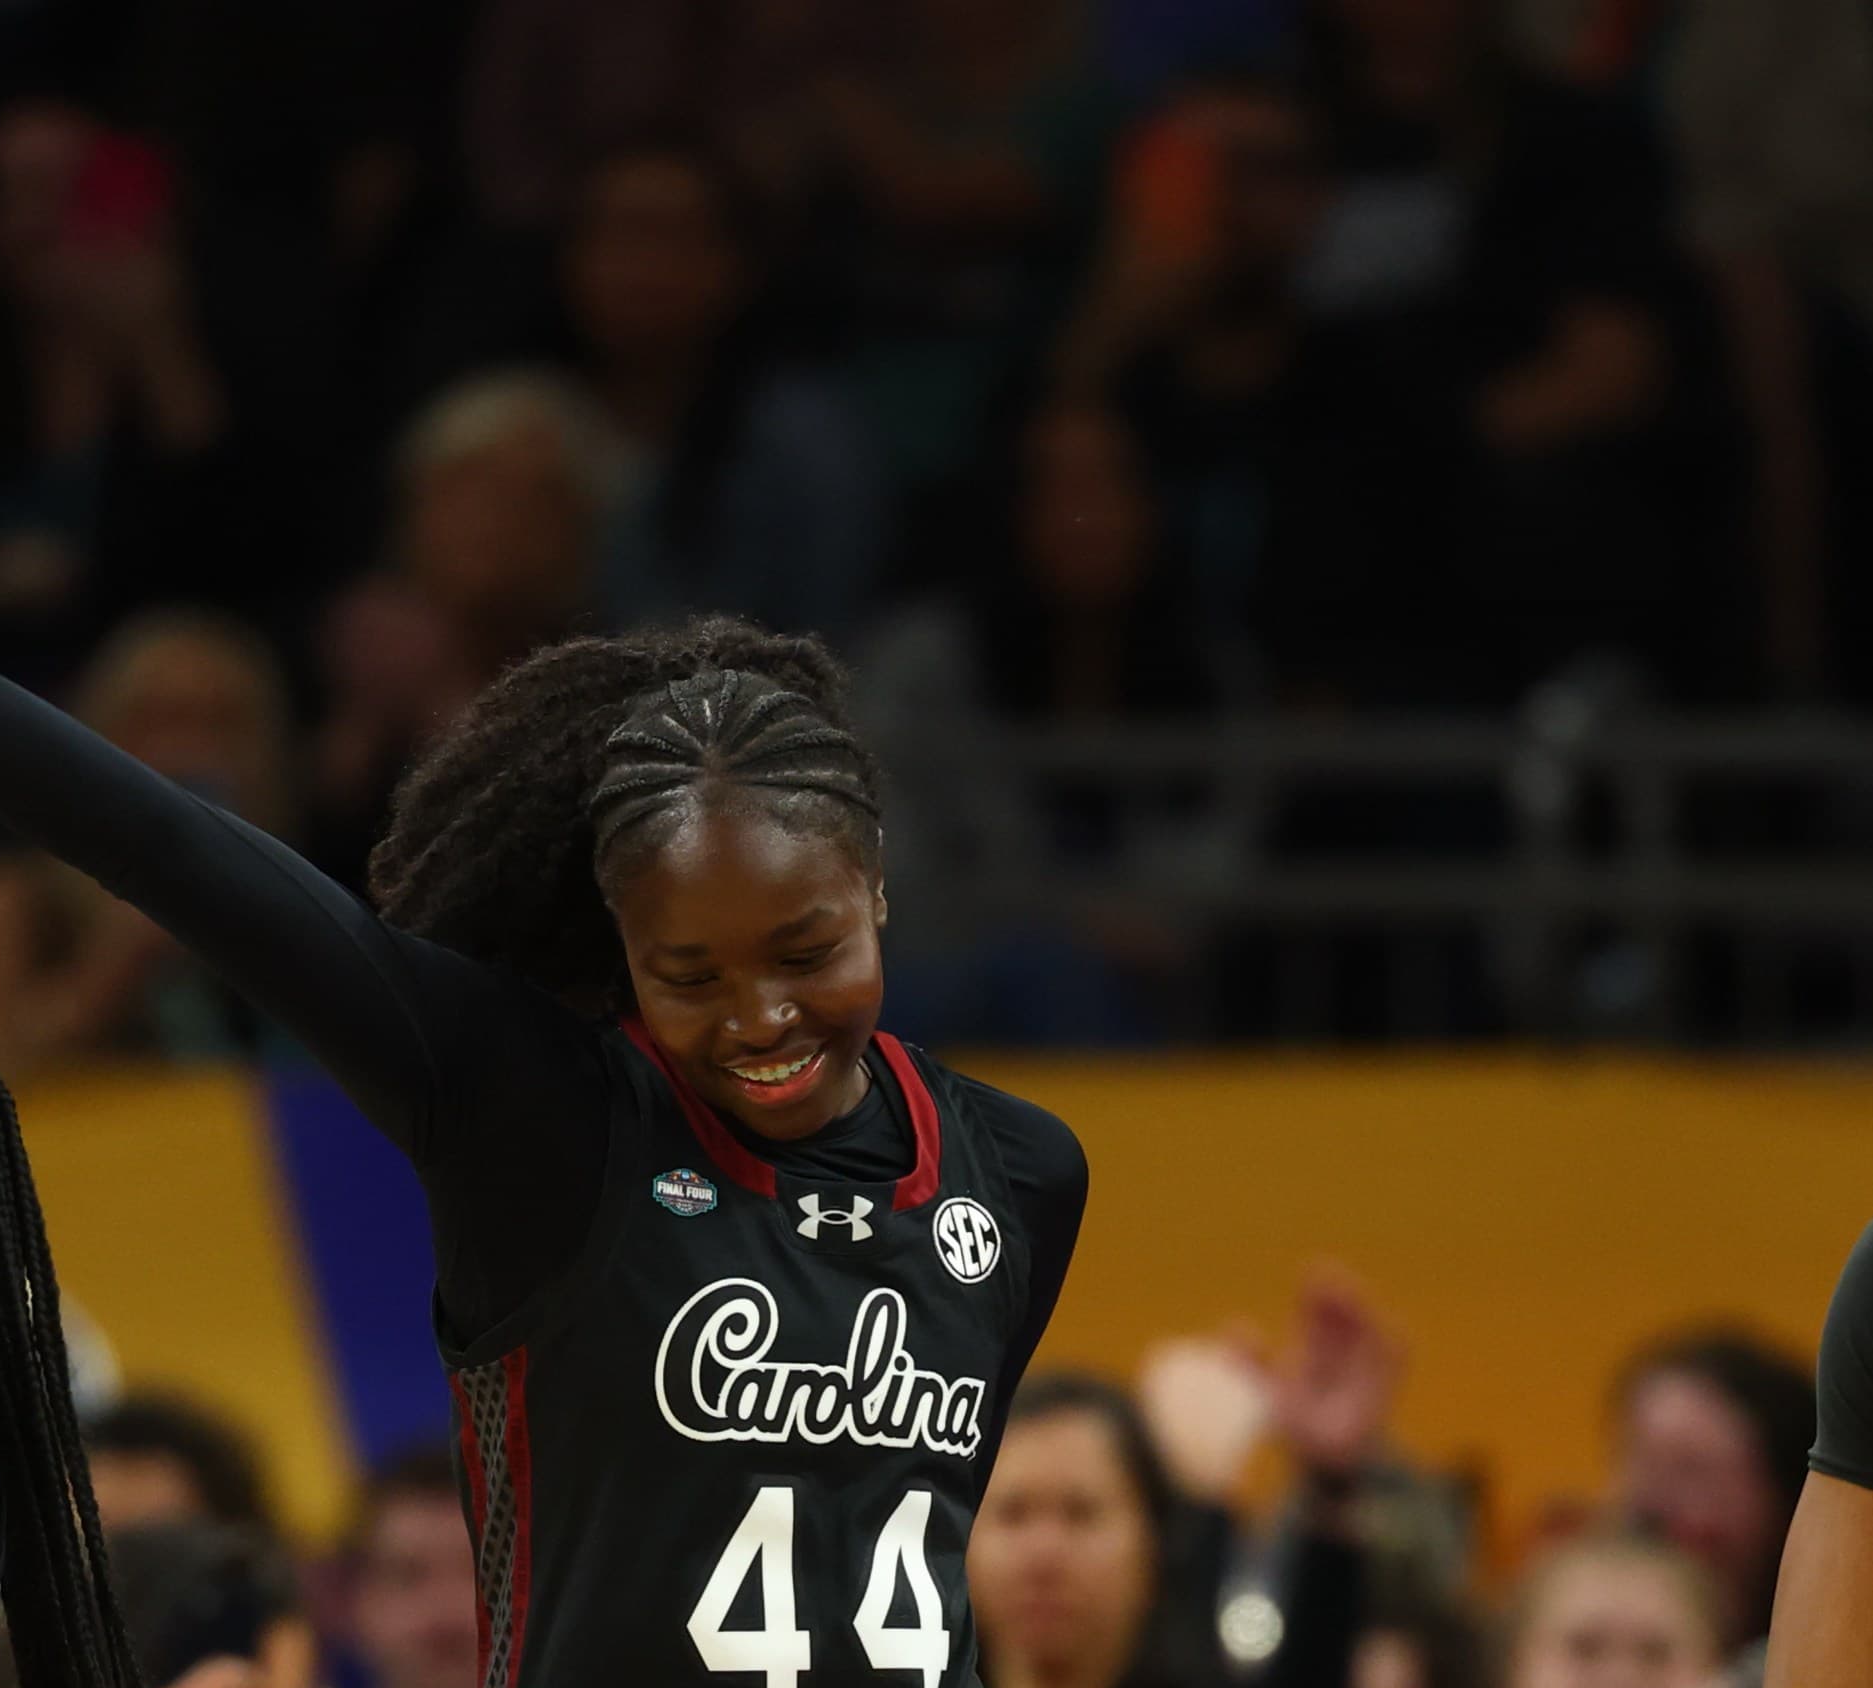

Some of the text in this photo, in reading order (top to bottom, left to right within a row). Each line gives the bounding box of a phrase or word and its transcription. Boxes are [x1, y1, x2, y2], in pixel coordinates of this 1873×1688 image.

[657, 1182, 713, 1201] FINAL FOUR
[937, 1202, 998, 1279] SEC
[655, 1277, 986, 1459] Carolina
